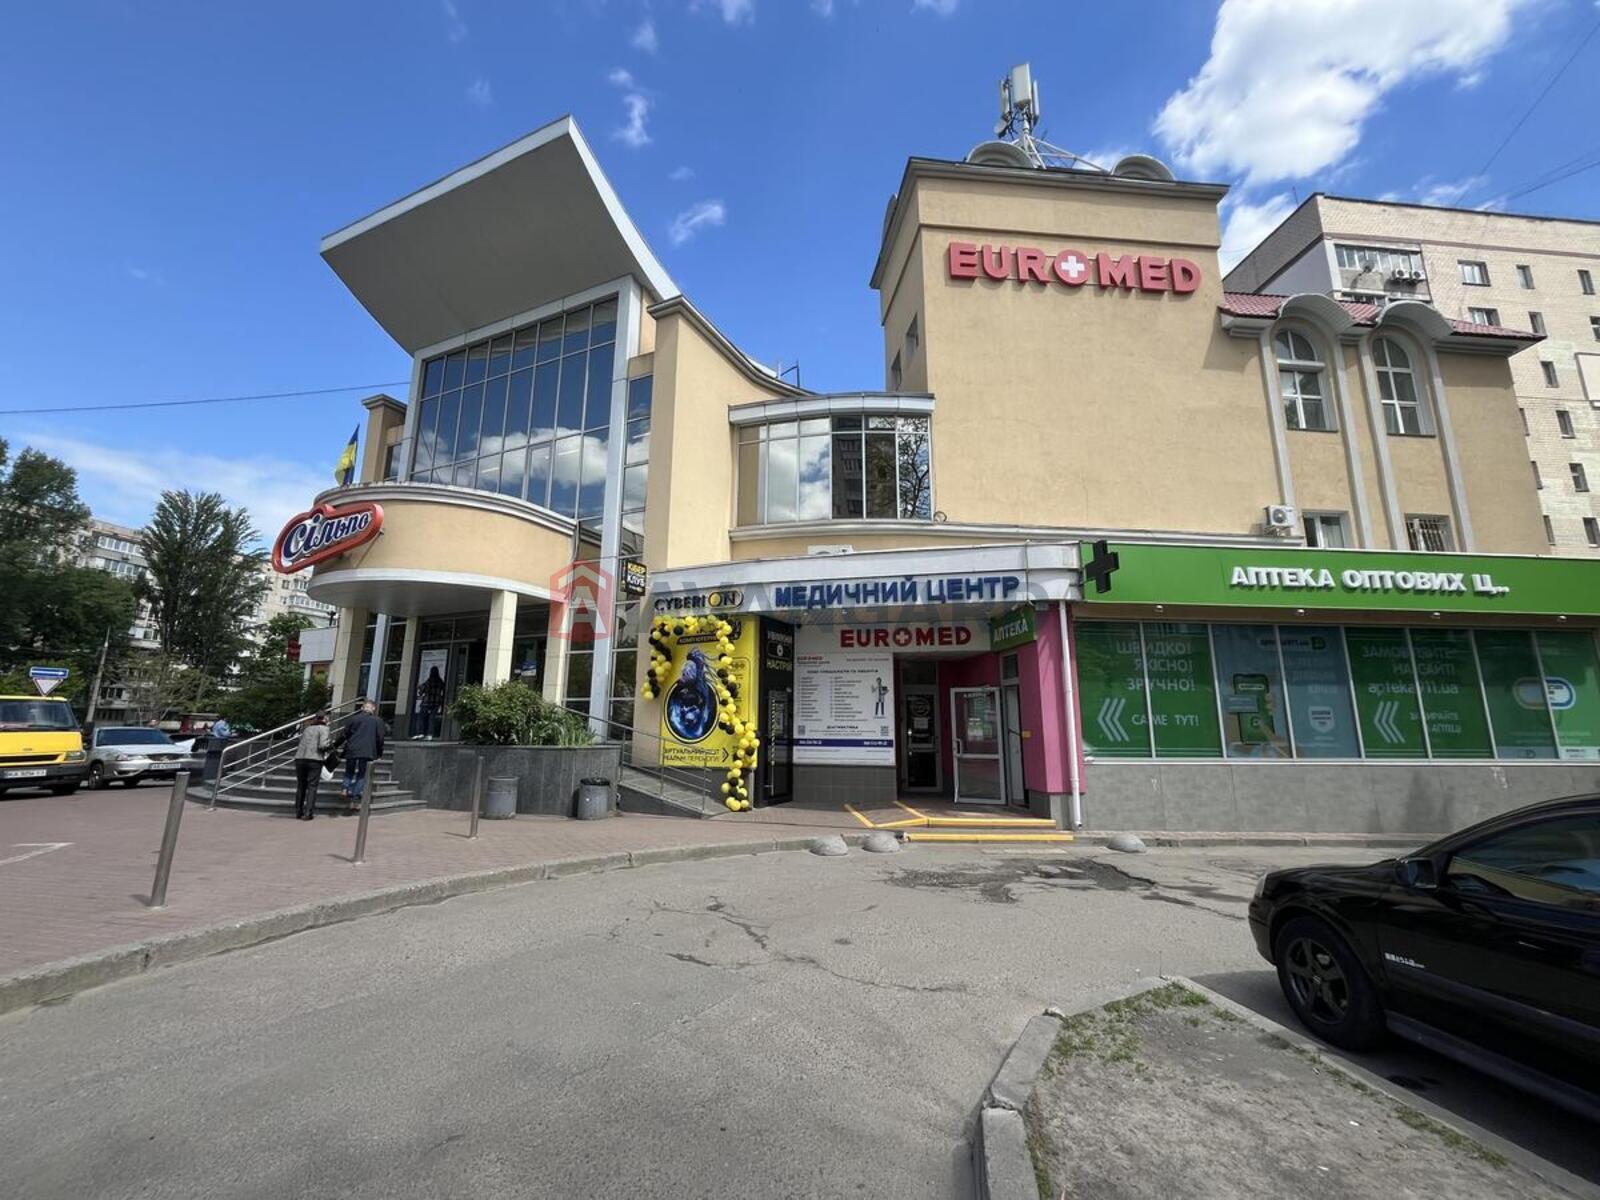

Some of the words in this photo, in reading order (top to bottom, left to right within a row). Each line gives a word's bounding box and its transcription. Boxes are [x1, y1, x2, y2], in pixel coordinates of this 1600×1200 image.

[948, 242, 1201, 292] EUROMED
[283, 513, 369, 558] Сільпо
[775, 576, 917, 609] МЕДИЧНИЙ
[927, 576, 1020, 604] ЦЕНТР
[1231, 567, 1335, 588] АПТЕКА
[1342, 570, 1466, 591] ОПТОВИХ
[840, 626, 971, 648] EUROMED
[993, 618, 1028, 641] АПТЕКА
